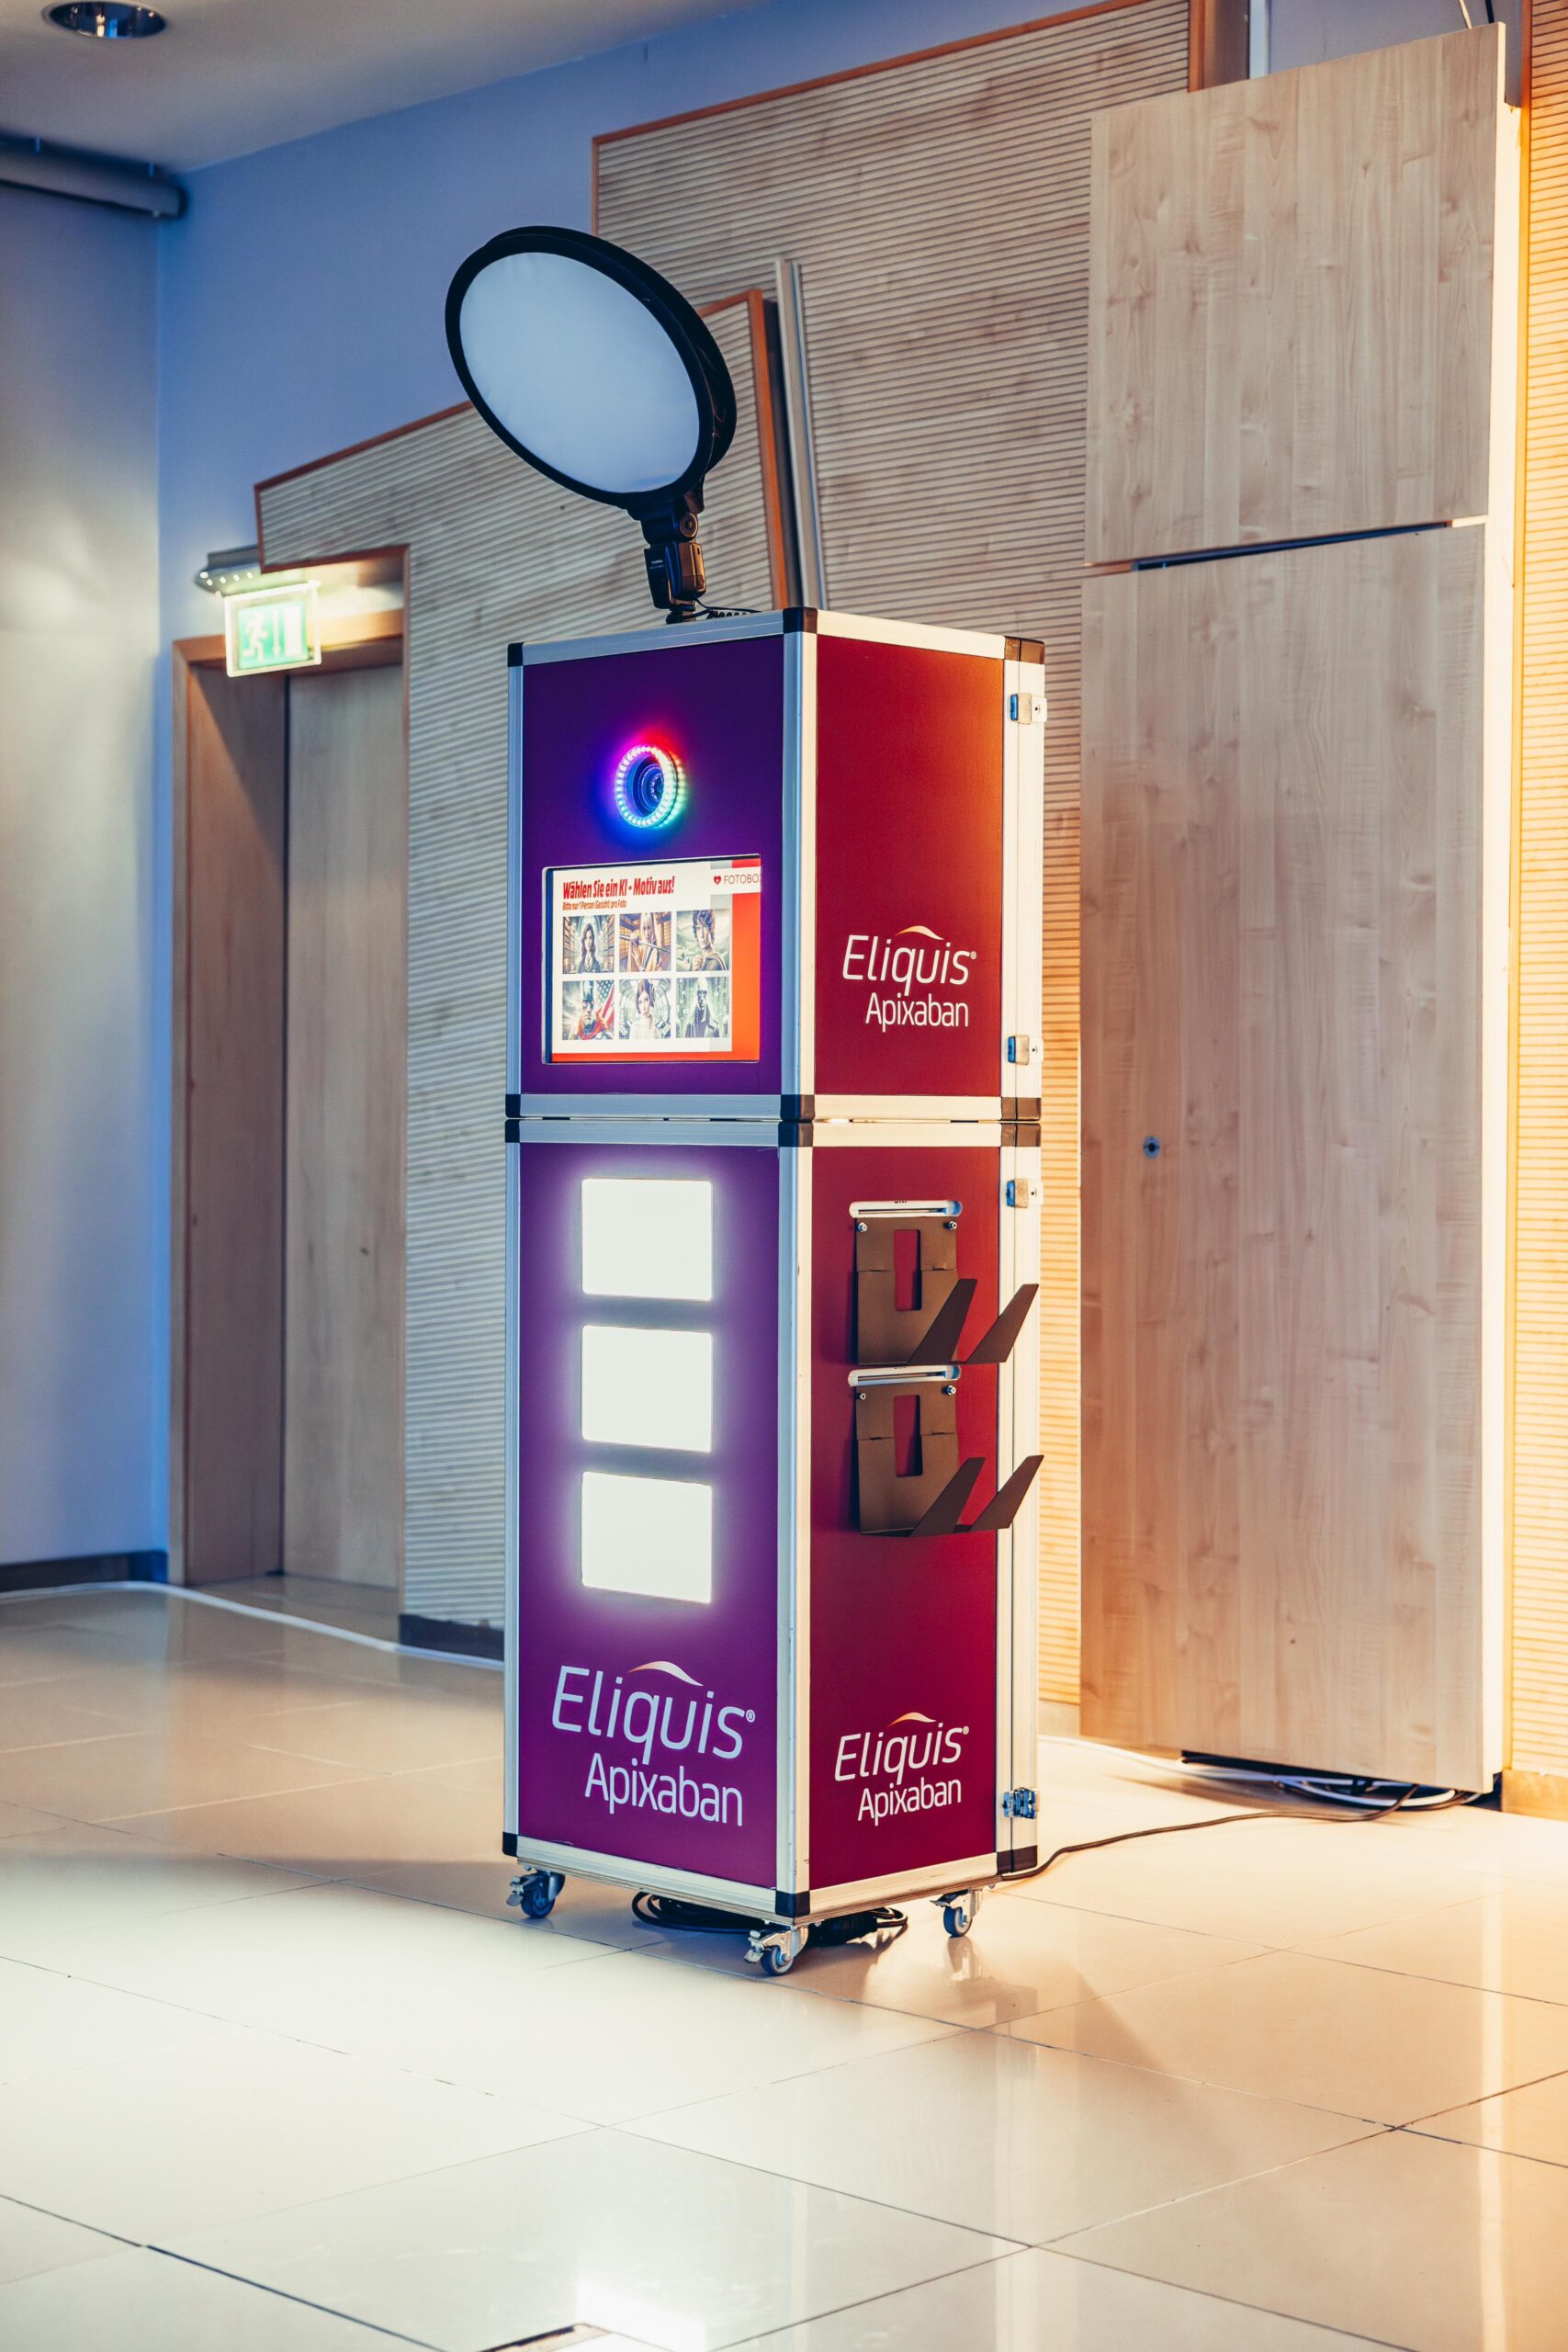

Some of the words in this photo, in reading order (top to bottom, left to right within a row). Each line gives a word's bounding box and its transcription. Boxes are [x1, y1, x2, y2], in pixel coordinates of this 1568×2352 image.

[563, 880, 592, 899] Wählen
[593, 879, 604, 898] Sie
[605, 878, 617, 897] ein
[619, 878, 627, 896] KI
[633, 876, 656, 895] Motiv
[658, 876, 675, 894] aus!
[724, 874, 761, 884] FOTOBO
[865, 992, 969, 1033] Apixaban
[584, 1752, 743, 1826] Apixaban
[857, 1776, 962, 1826] Apixaban
